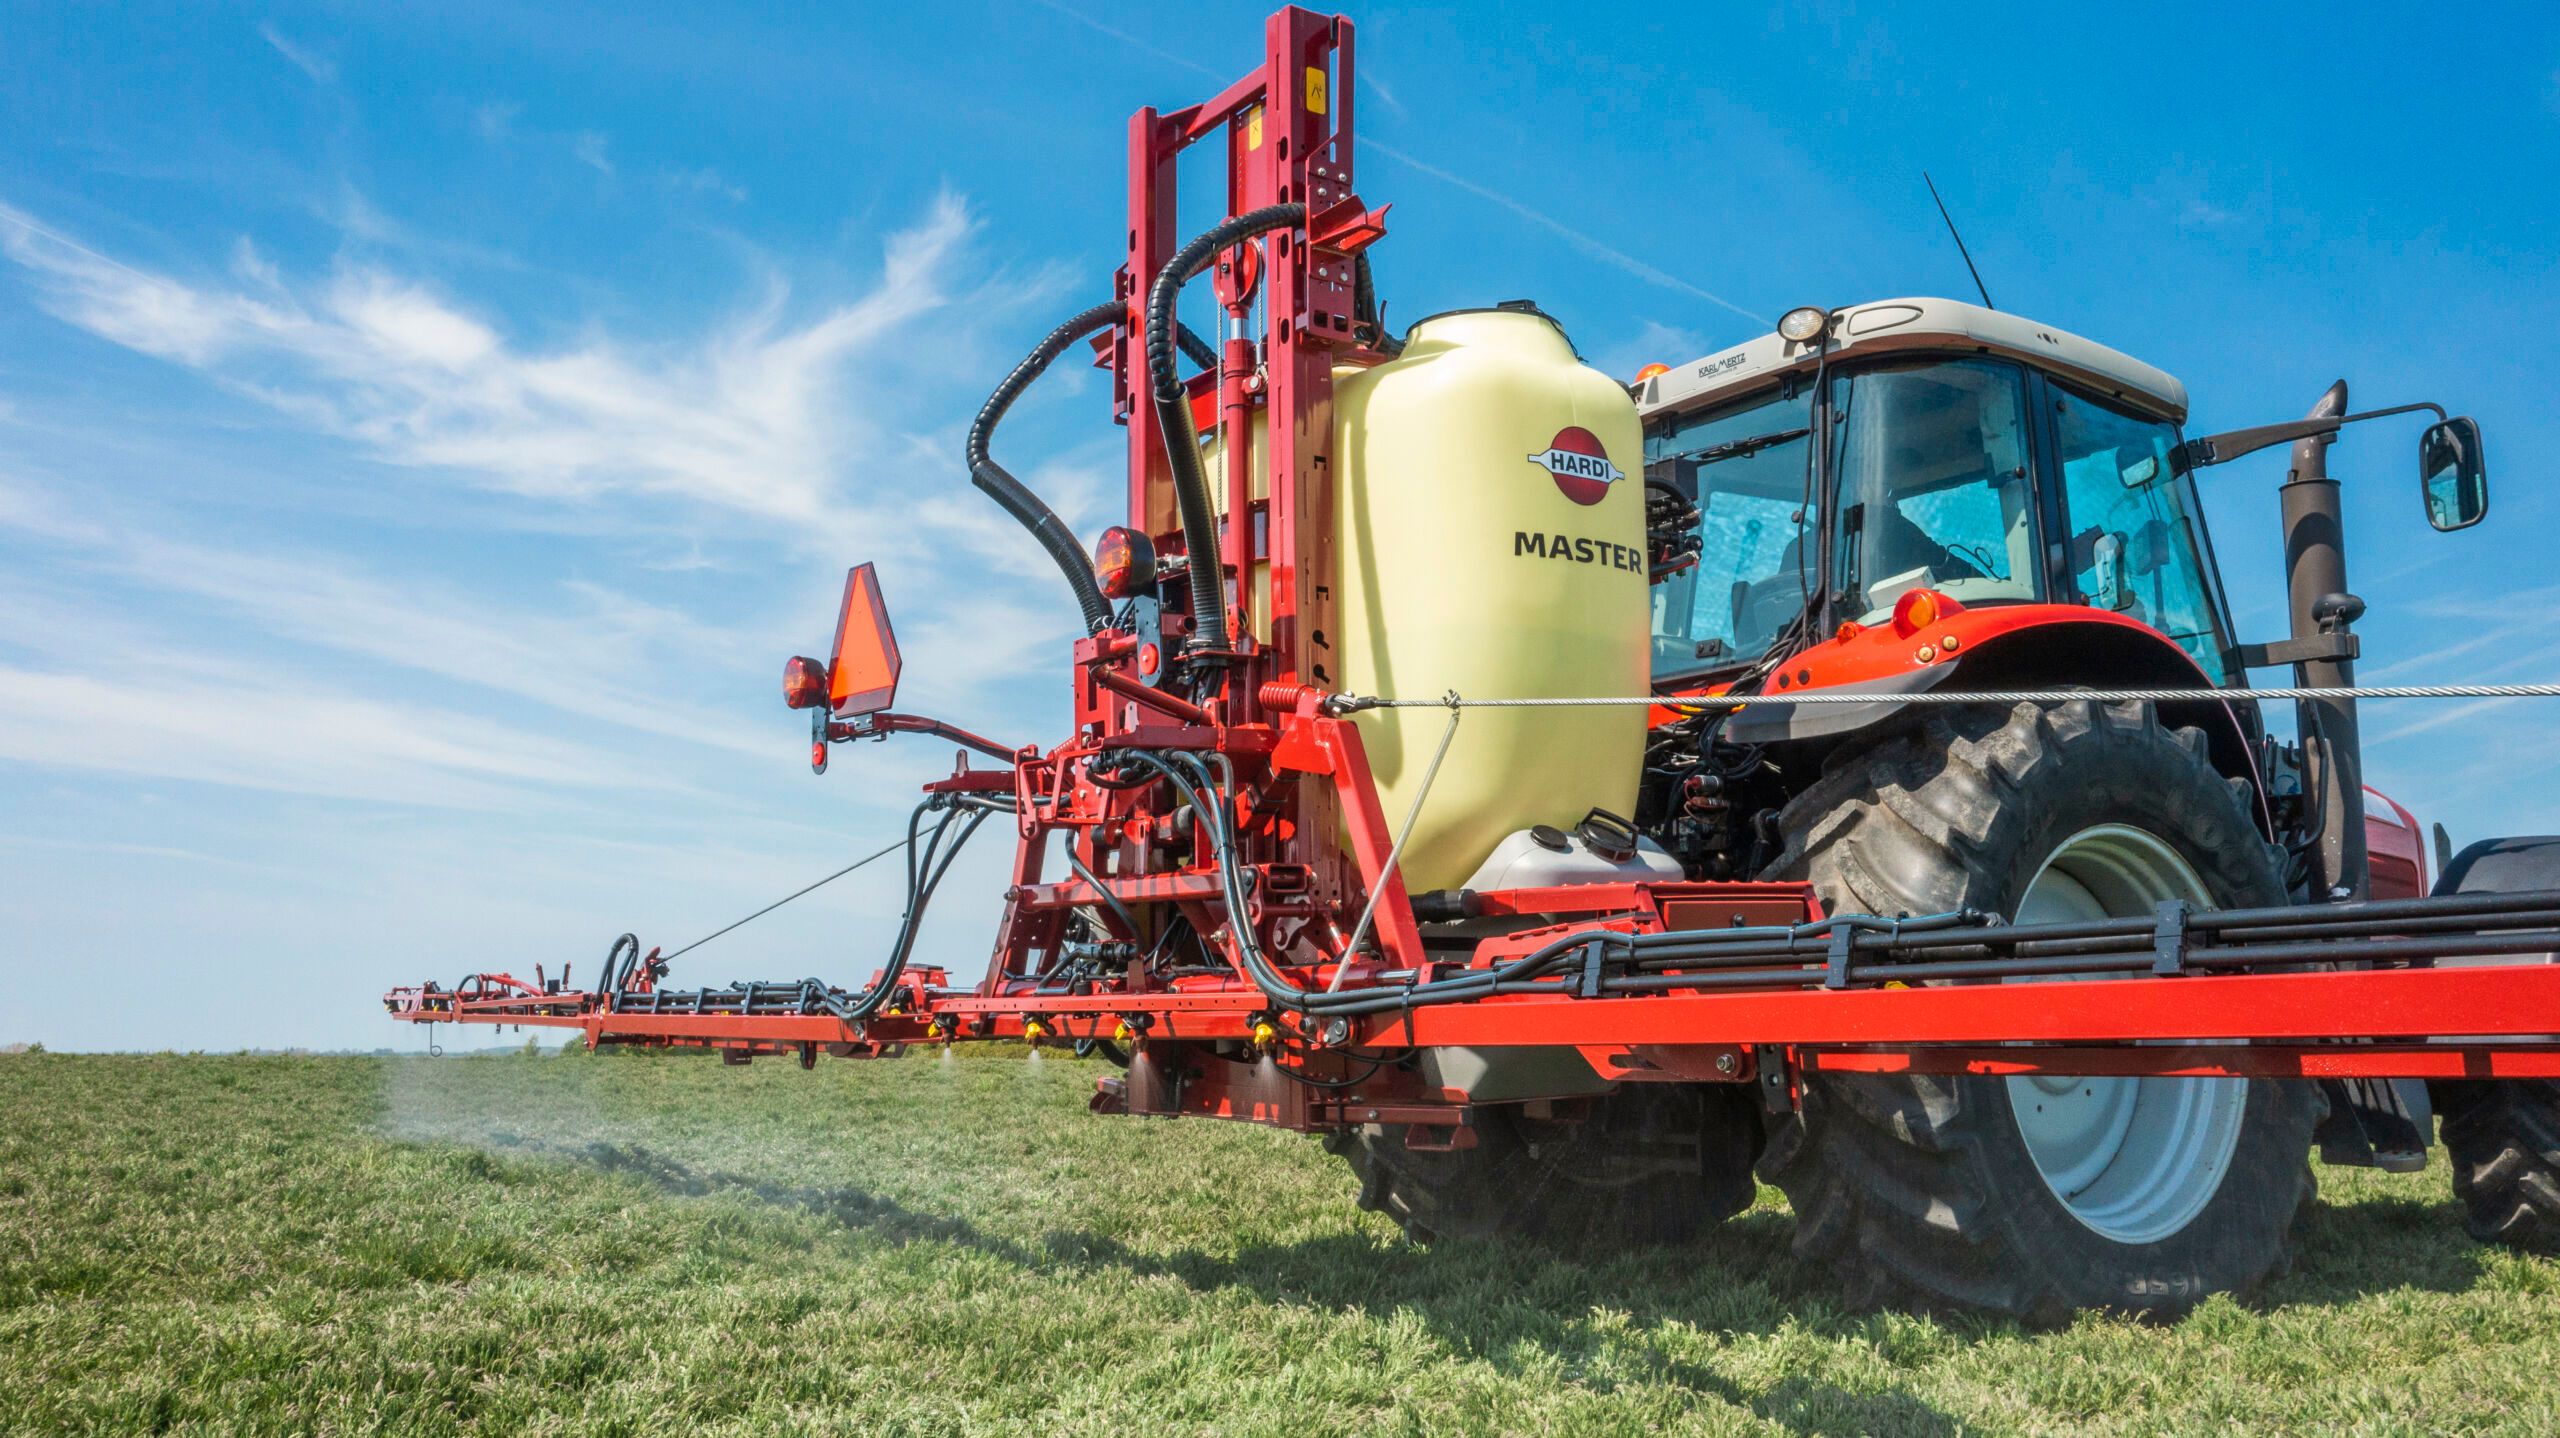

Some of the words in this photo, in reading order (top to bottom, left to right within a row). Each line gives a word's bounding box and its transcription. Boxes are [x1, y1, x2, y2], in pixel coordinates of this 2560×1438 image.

[1698, 362, 1718, 377] KARL
[1718, 353, 1746, 368] MERTZ
[1551, 452, 1610, 479] HARDI
[1514, 531, 1642, 575] MASTER
